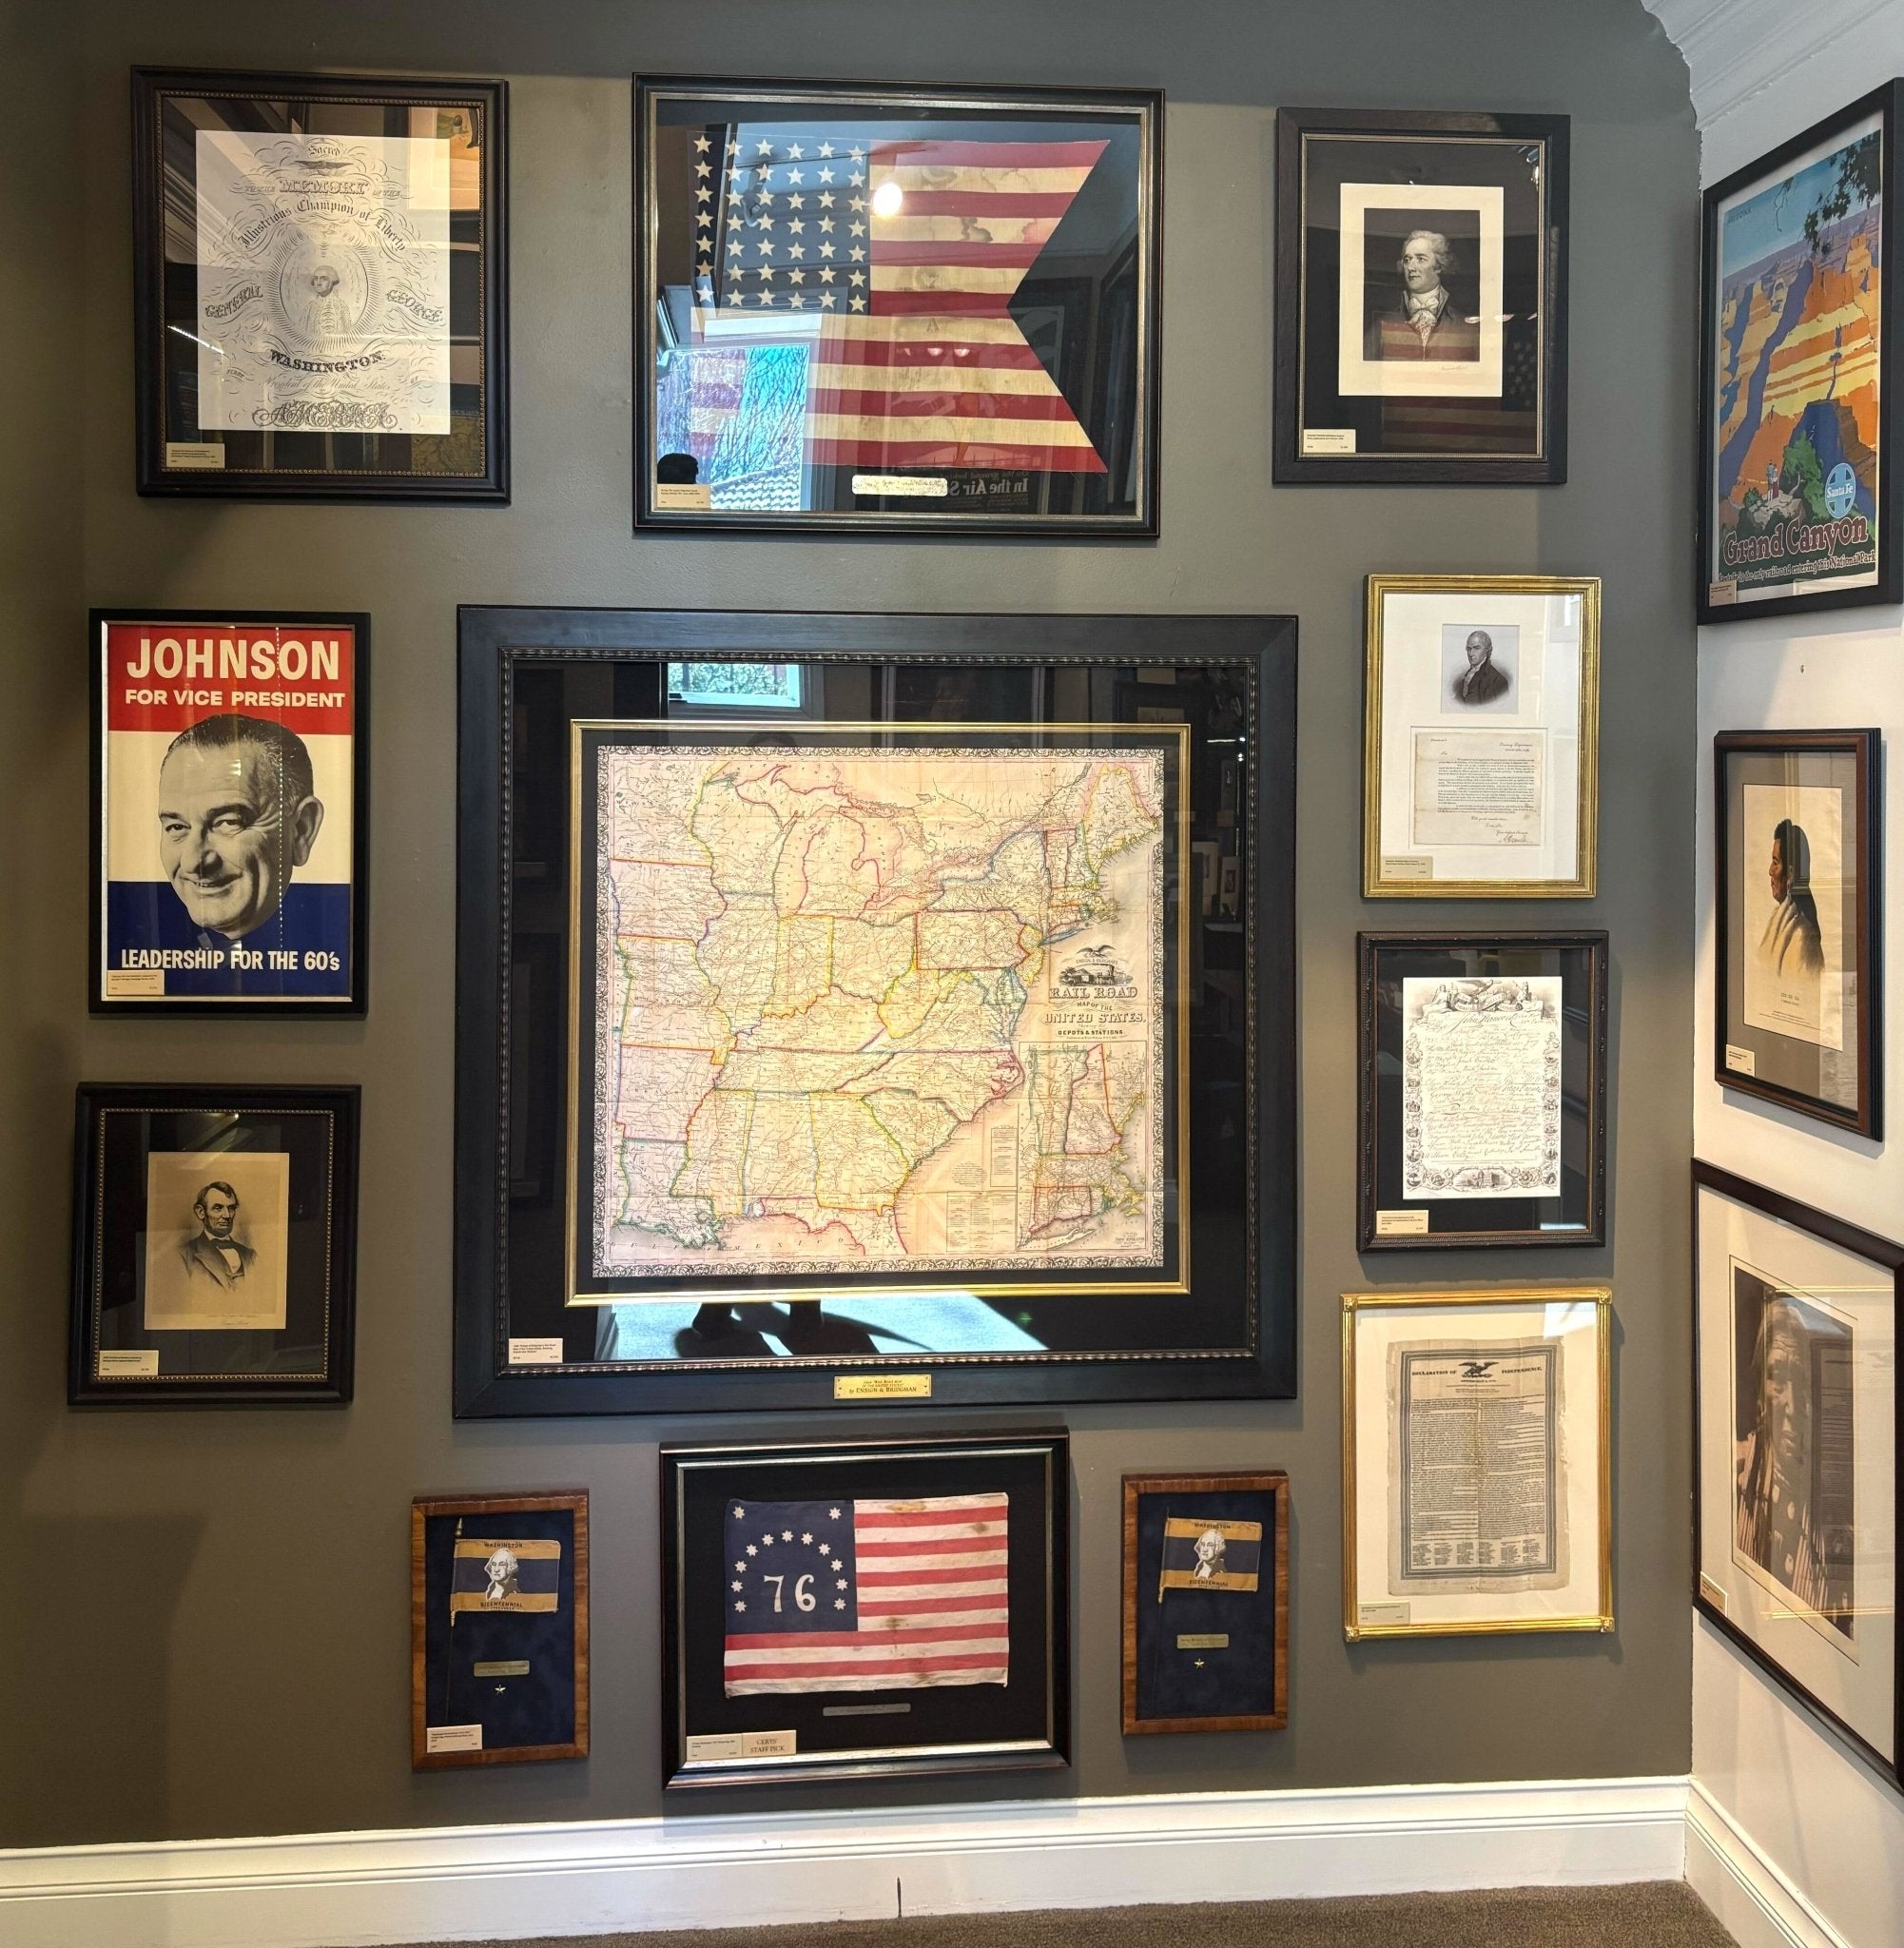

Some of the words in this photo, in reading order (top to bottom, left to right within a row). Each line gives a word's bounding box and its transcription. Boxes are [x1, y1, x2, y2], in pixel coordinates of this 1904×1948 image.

[279, 179, 369, 194] MEMORY
[297, 199, 354, 215] Champion
[375, 217, 406, 252] Liberty
[204, 285, 263, 318] GENERAL
[1827, 486, 1844, 498] Santa
[1845, 483, 1854, 494] Fe
[1722, 523, 1784, 566] Grand
[1786, 516, 1869, 555] Canyon
[1792, 560, 1817, 575] entering
[1817, 558, 1830, 571] this
[1830, 554, 1861, 569] National
[1861, 549, 1876, 563] Park
[126, 638, 340, 680] JOHNSON
[126, 690, 168, 706] FOR
[174, 690, 223, 707] VICE
[231, 691, 345, 708] PRESIDENT
[122, 948, 223, 969] LEADERSHIP
[230, 949, 263, 970] FOR
[267, 950, 299, 970] THE
[303, 951, 340, 971] 60's
[1049, 987, 1091, 1000] RAIL
[1093, 986, 1138, 1000] ROAD
[1045, 1013, 1094, 1023] UNITED
